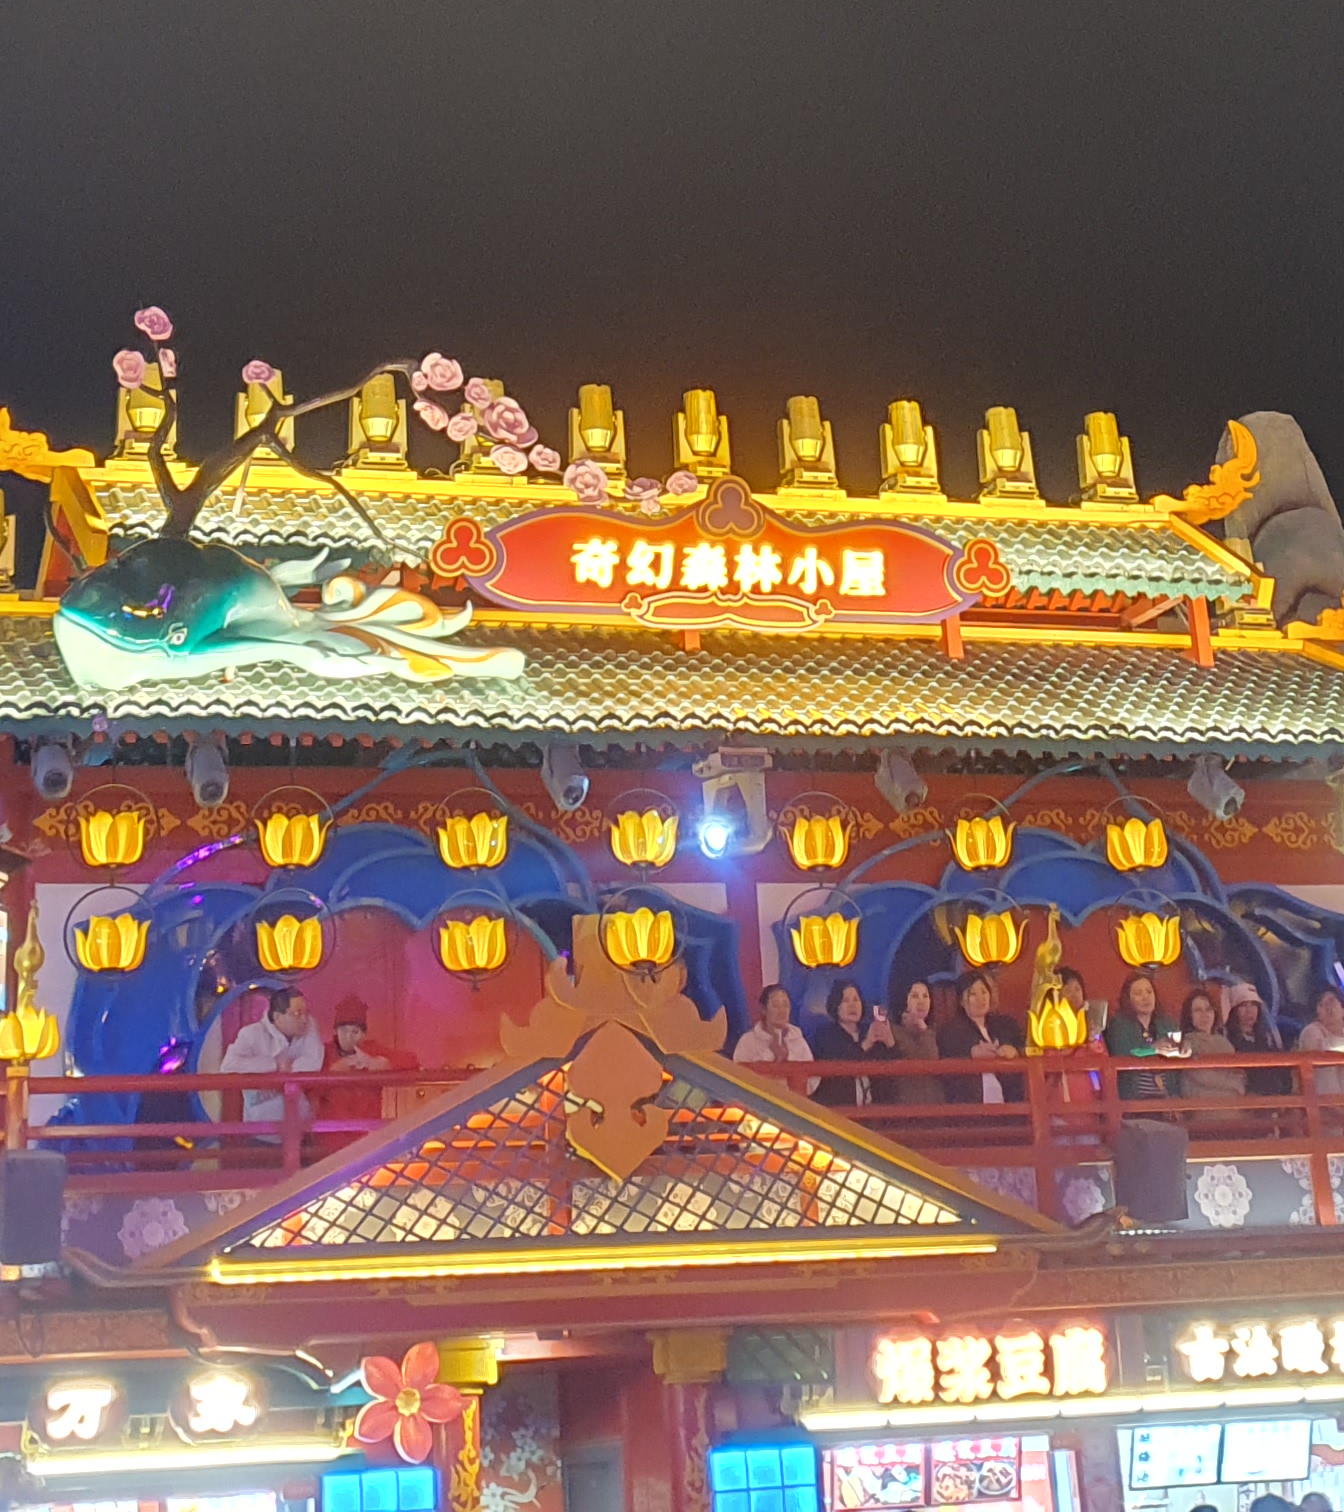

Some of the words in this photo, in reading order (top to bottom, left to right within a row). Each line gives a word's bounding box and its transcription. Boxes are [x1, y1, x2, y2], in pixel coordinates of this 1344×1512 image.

[570, 538, 886, 596] 奇幻森林小屋
[874, 1326, 1107, 1404] 爆浆豆腐
